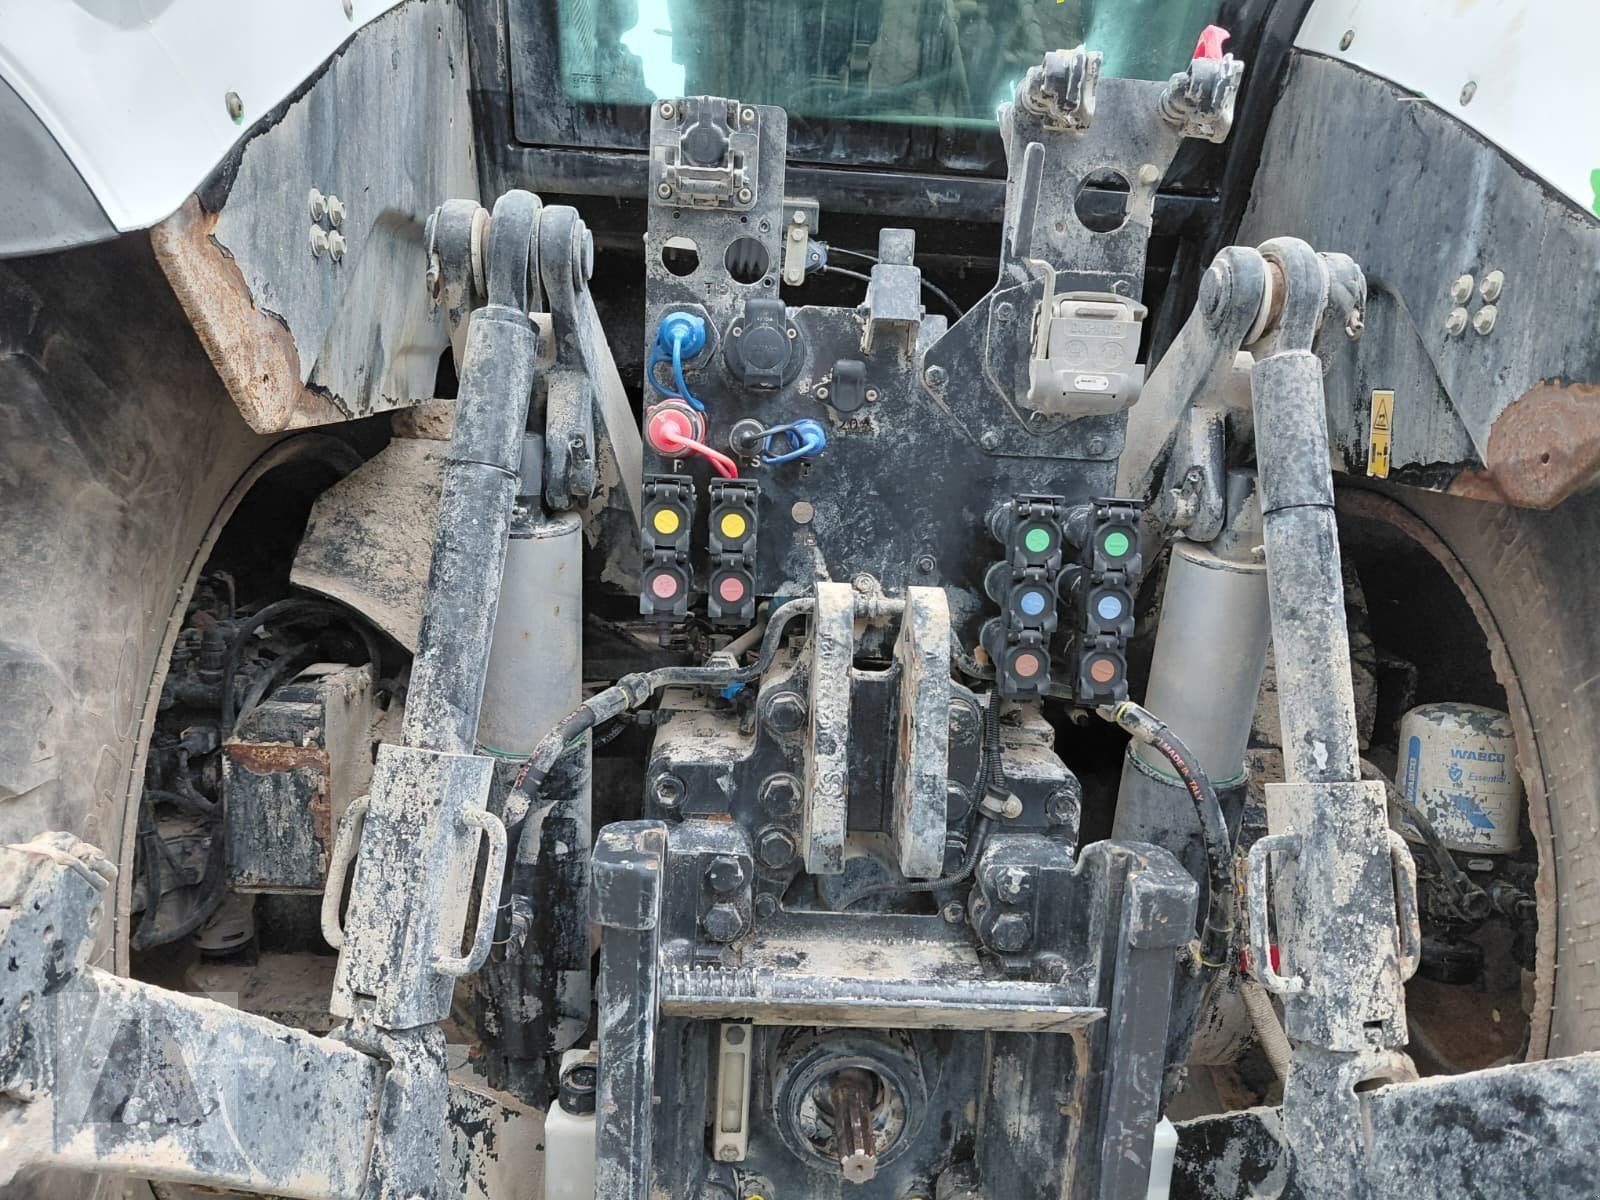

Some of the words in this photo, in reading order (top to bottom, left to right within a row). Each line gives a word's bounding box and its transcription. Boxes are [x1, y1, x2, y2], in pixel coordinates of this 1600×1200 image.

[1162, 743, 1185, 767] MADE
[1188, 778, 1205, 801] TALY
[1451, 749, 1505, 763] WABCO
